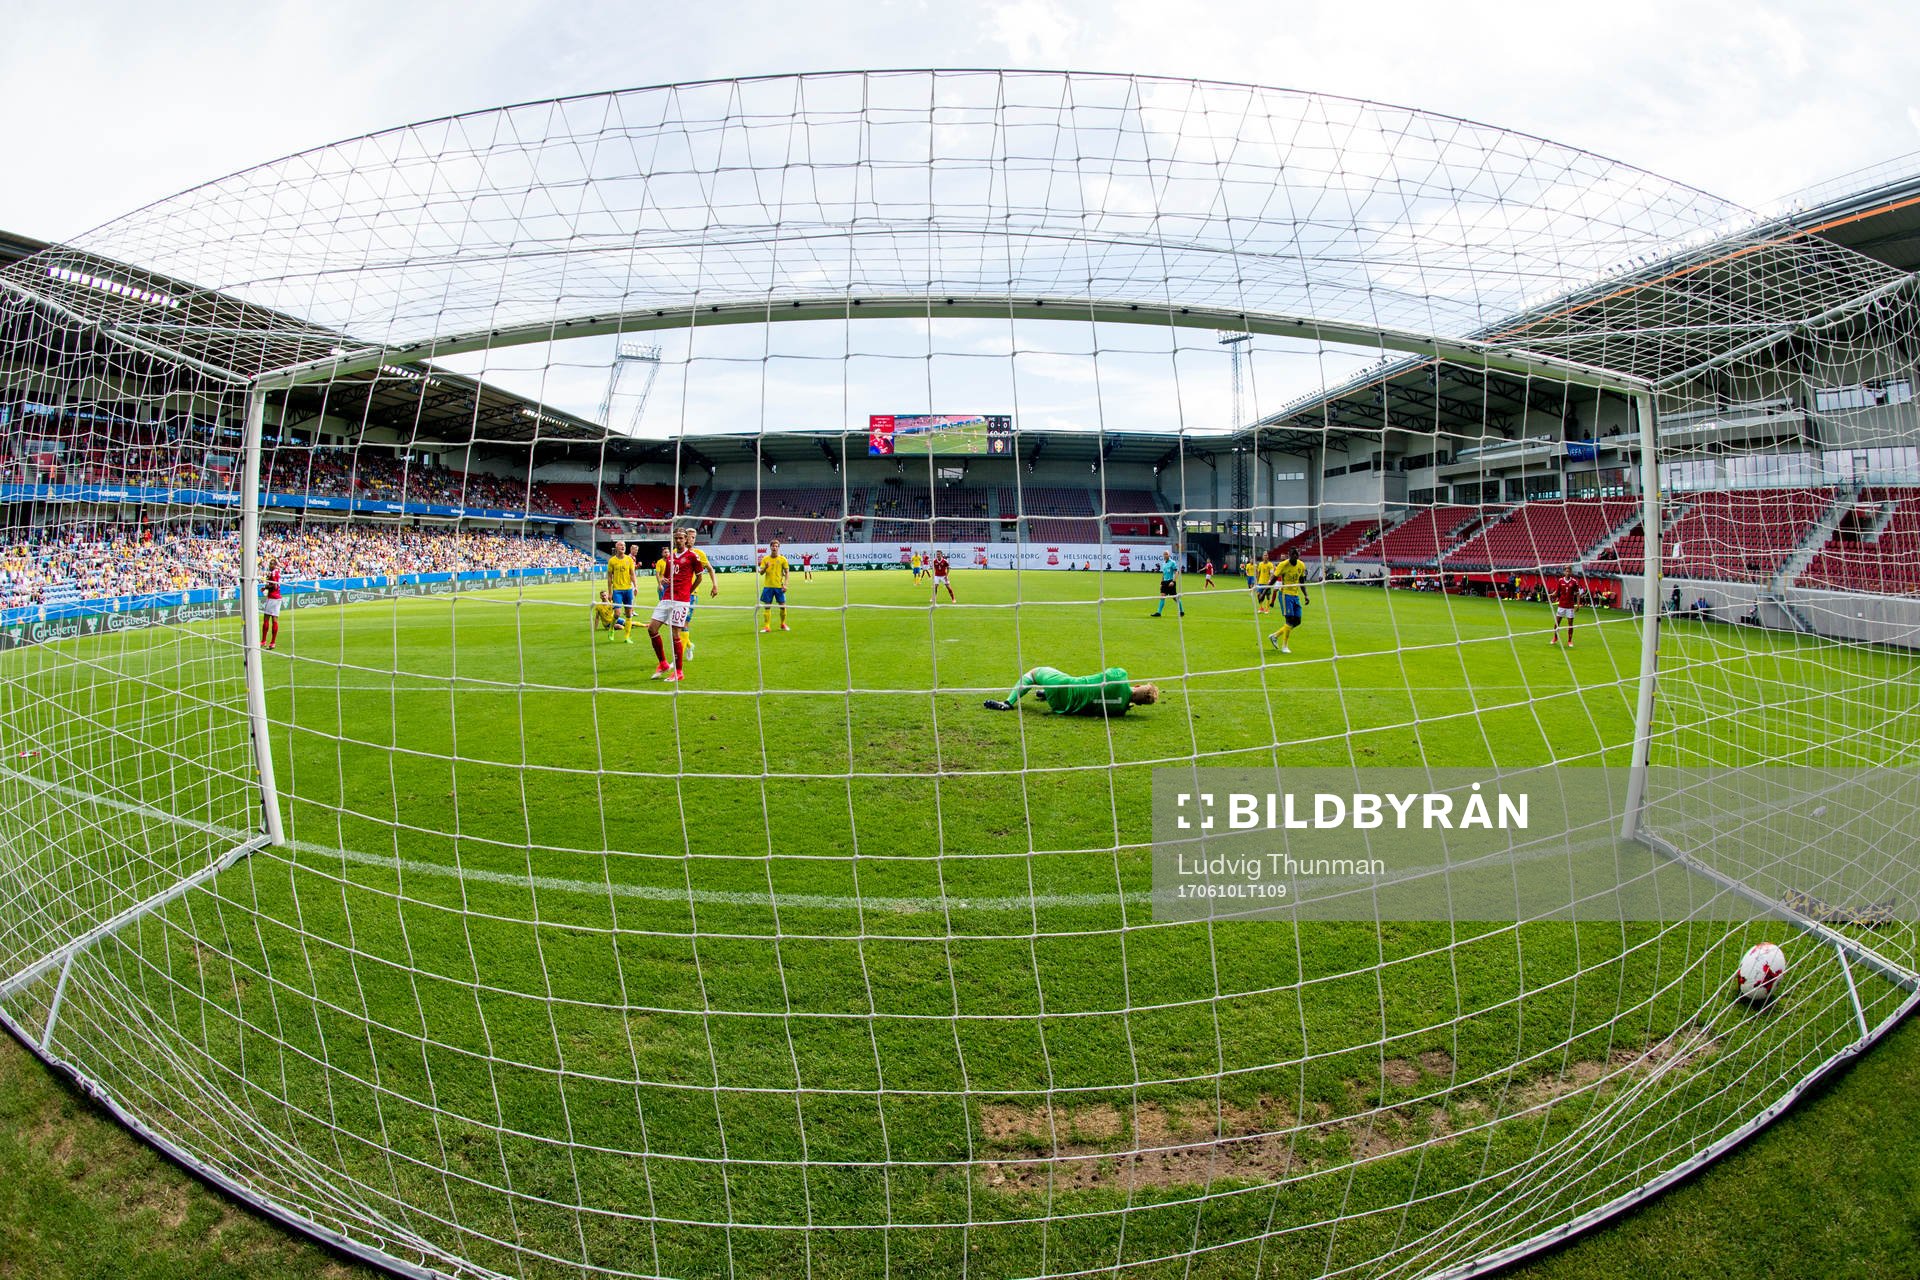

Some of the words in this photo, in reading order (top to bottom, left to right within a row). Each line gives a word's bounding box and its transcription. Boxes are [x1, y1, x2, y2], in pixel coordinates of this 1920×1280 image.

[296, 593, 328, 608] Carlsberg
[107, 613, 150, 630] Carlsberg
[177, 605, 215, 622] Carlsberg
[32, 621, 78, 643] Carlsberg
